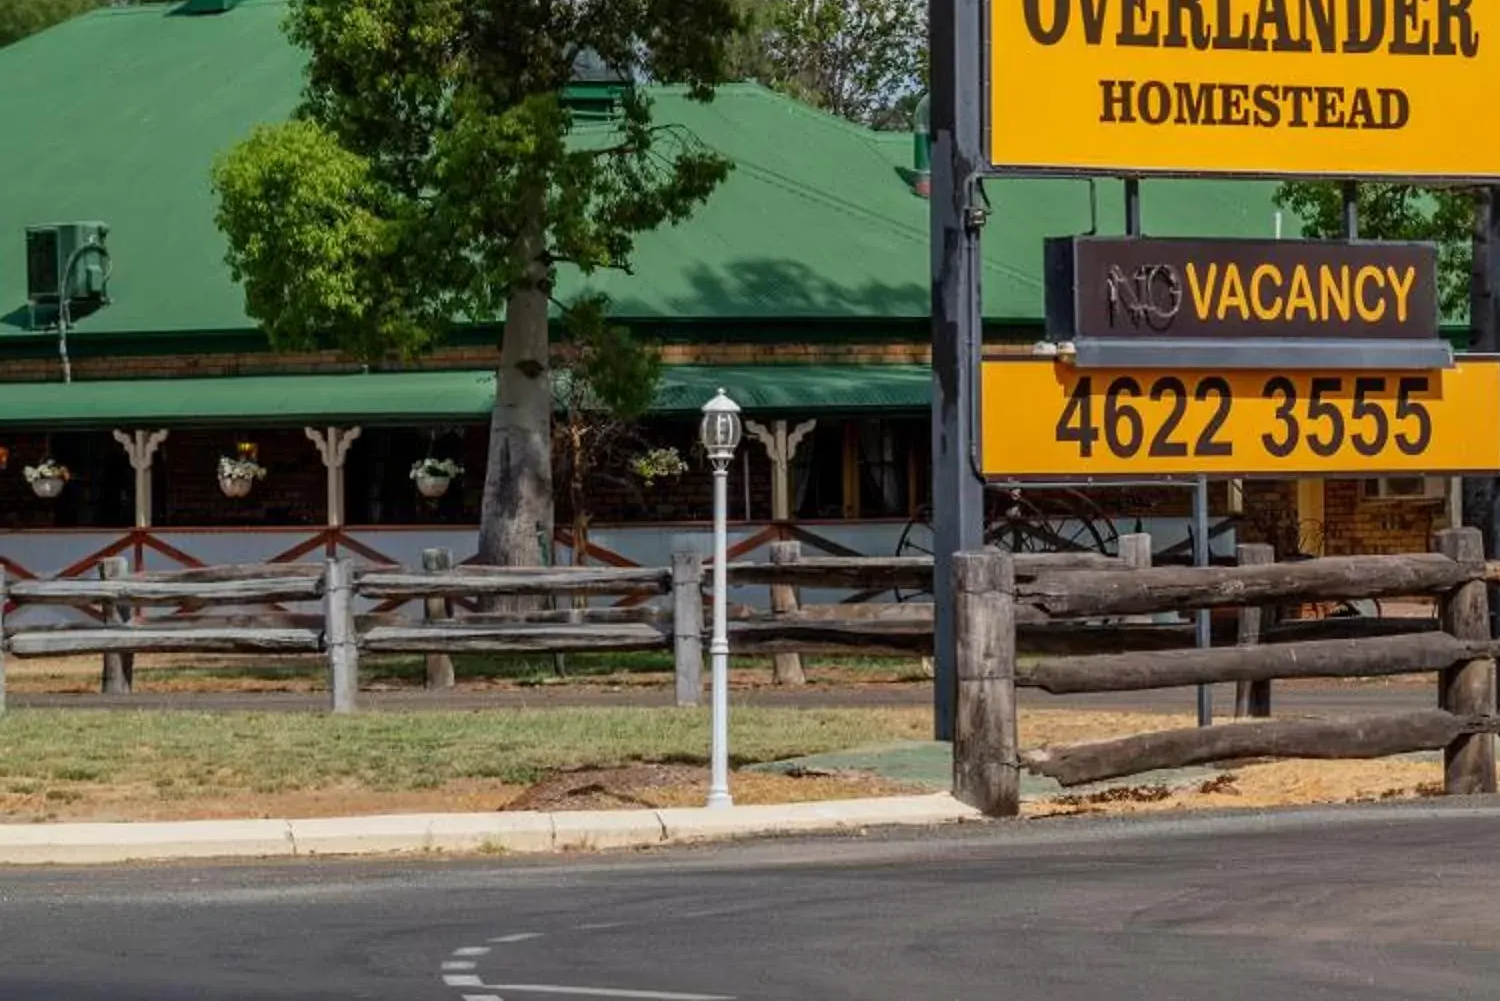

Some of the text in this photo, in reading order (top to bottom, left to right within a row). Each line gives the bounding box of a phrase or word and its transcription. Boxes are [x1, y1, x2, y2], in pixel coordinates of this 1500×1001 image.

[1099, 79, 1410, 130] HOMESTEAD
[1106, 261, 1416, 331] NO VACANCY
[1055, 375, 1432, 458] 4622 3555
